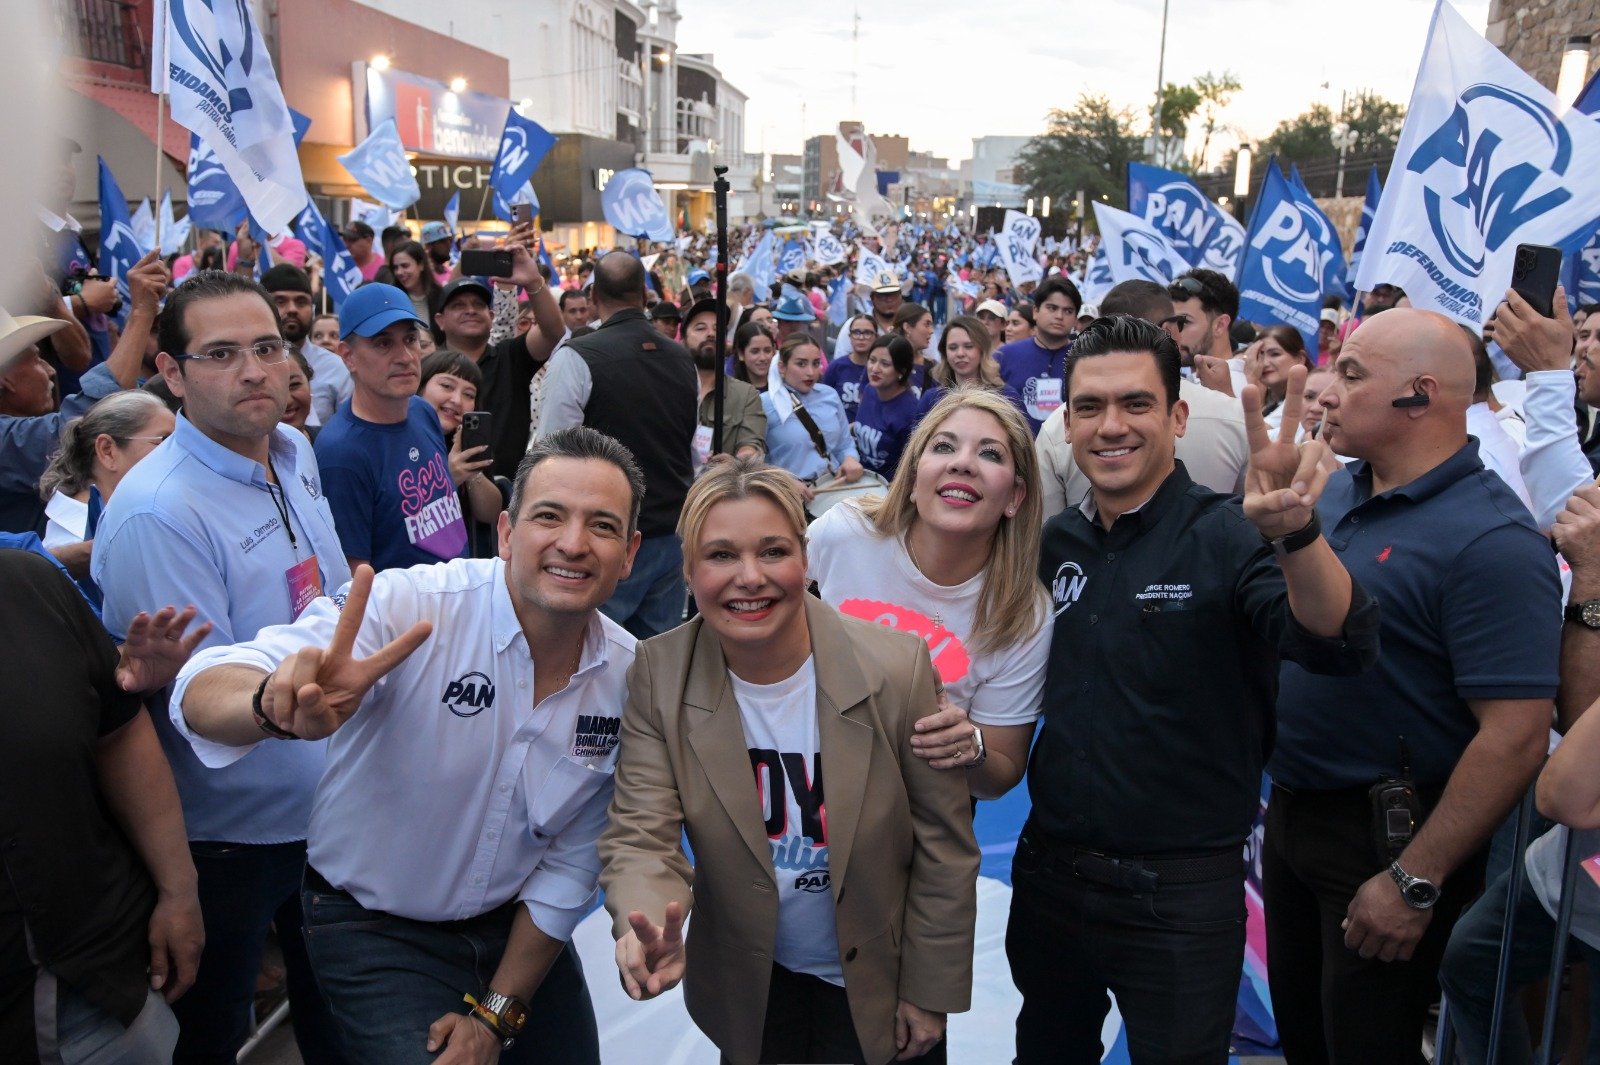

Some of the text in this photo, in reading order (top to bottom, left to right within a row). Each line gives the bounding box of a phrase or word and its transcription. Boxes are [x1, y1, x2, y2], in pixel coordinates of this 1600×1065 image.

[1407, 100, 1574, 253] PAN
[1144, 193, 1217, 248] PAN
[240, 536, 253, 550] Luis
[253, 517, 278, 538] Olmedo
[442, 681, 496, 709] PAN
[575, 734, 608, 748] BONILLA
[576, 715, 621, 735] MARCO
[769, 835, 829, 871] ilia
